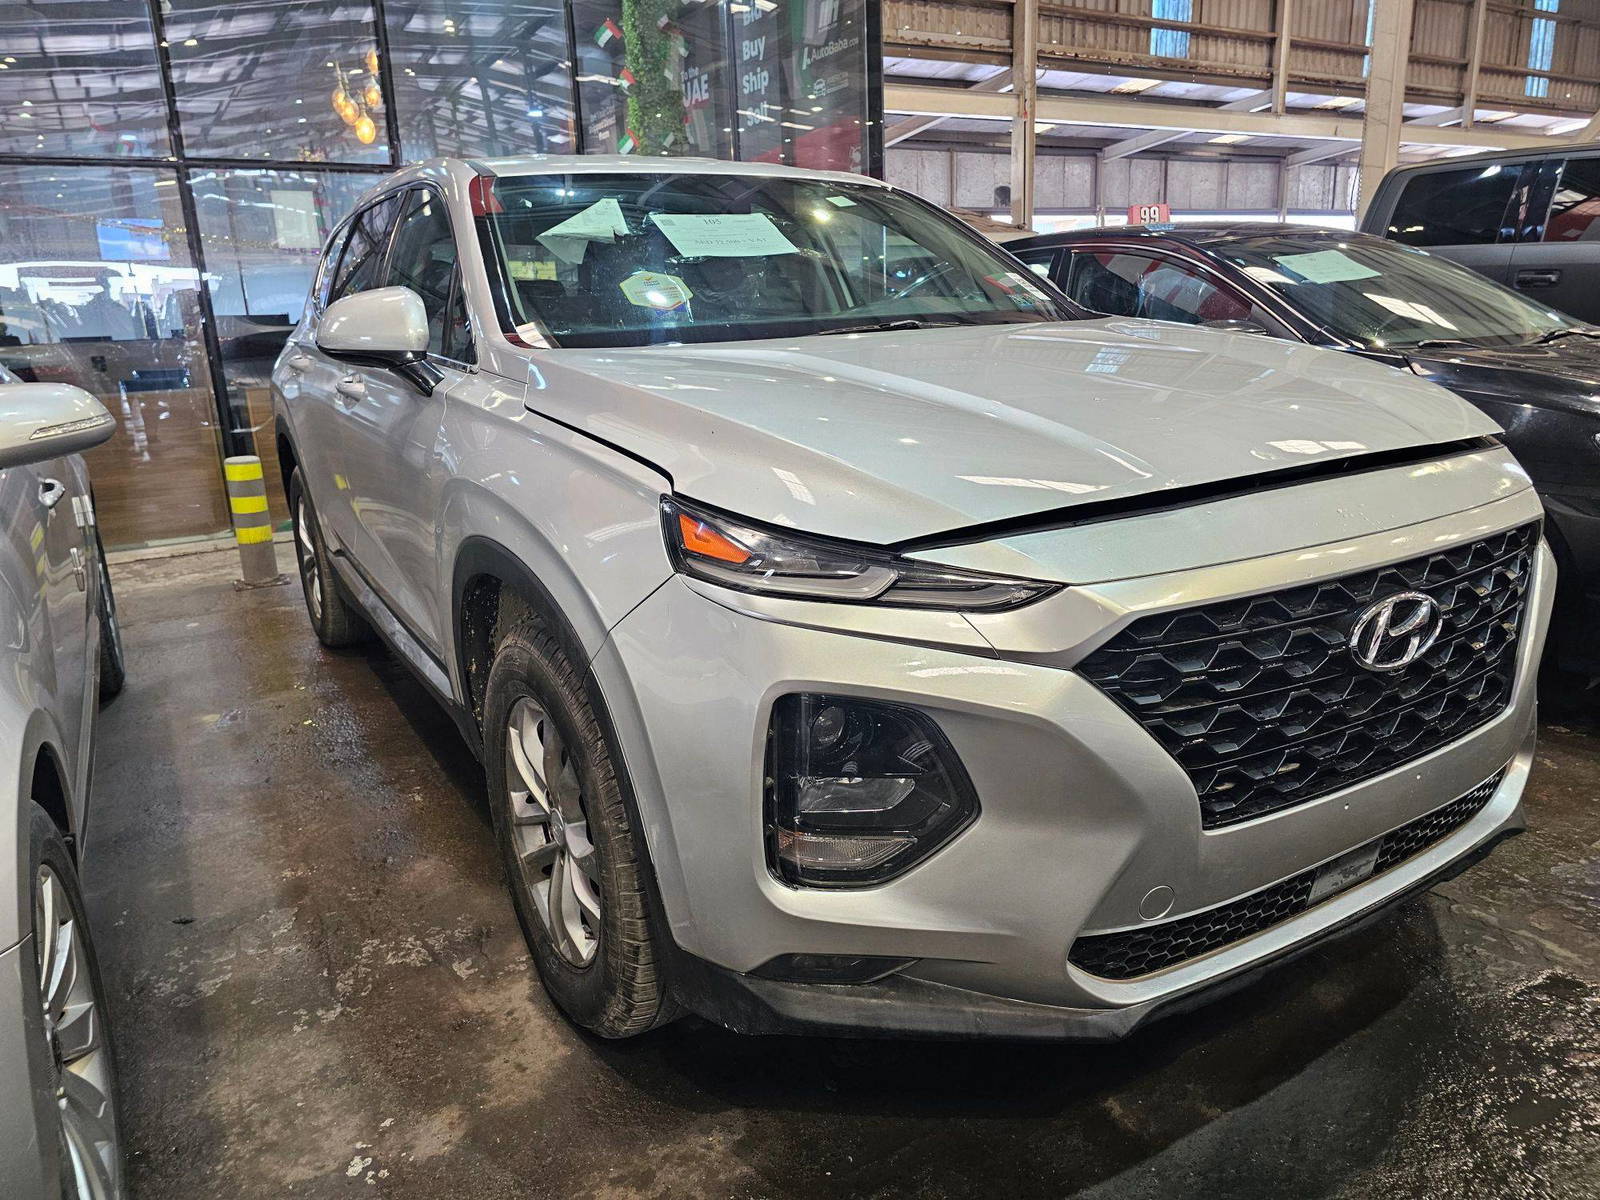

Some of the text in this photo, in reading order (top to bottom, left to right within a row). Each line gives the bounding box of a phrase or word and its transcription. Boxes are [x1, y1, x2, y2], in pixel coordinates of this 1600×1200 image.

[742, 36, 766, 61] Buy
[682, 73, 709, 108] UAE
[743, 67, 769, 95] Ship
[747, 101, 768, 126] Sell
[1140, 206, 1159, 225] 99
